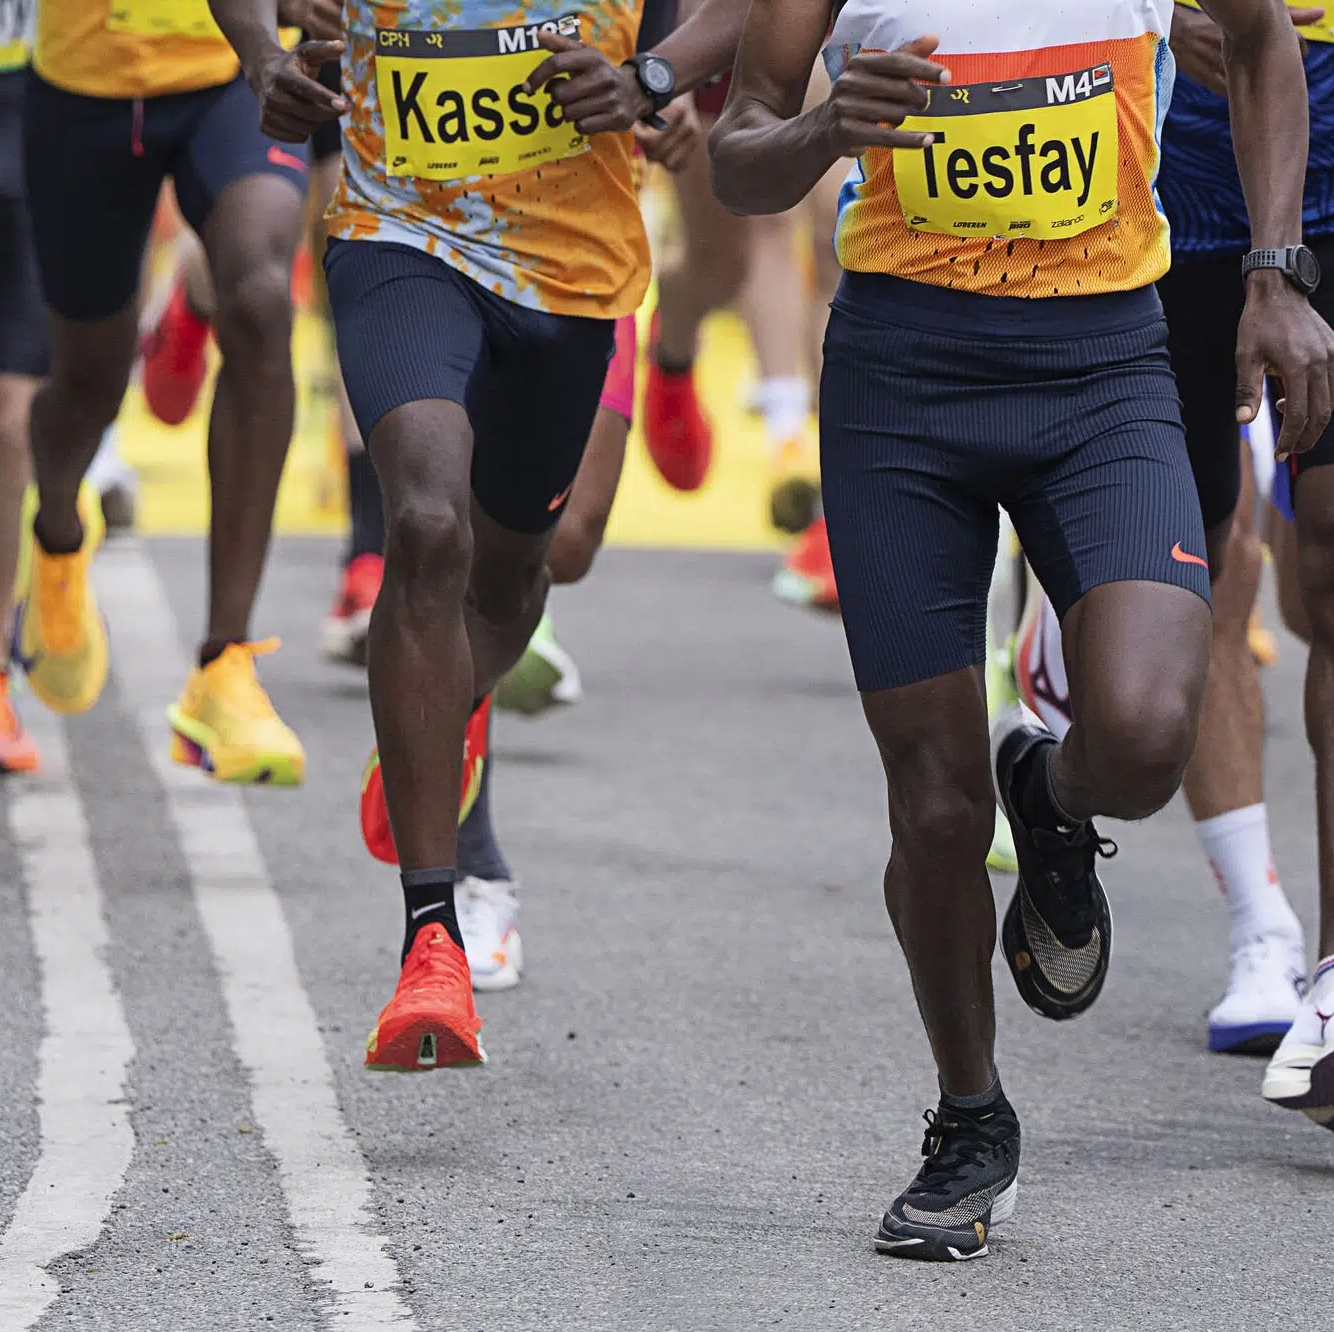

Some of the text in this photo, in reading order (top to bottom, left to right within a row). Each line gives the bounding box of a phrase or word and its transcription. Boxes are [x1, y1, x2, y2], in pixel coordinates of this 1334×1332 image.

[379, 31, 410, 47] CPH
[1046, 71, 1092, 104] M4
[391, 69, 585, 144] Kassa
[923, 123, 1099, 208] Tesfay
[1051, 214, 1085, 229] zalando
